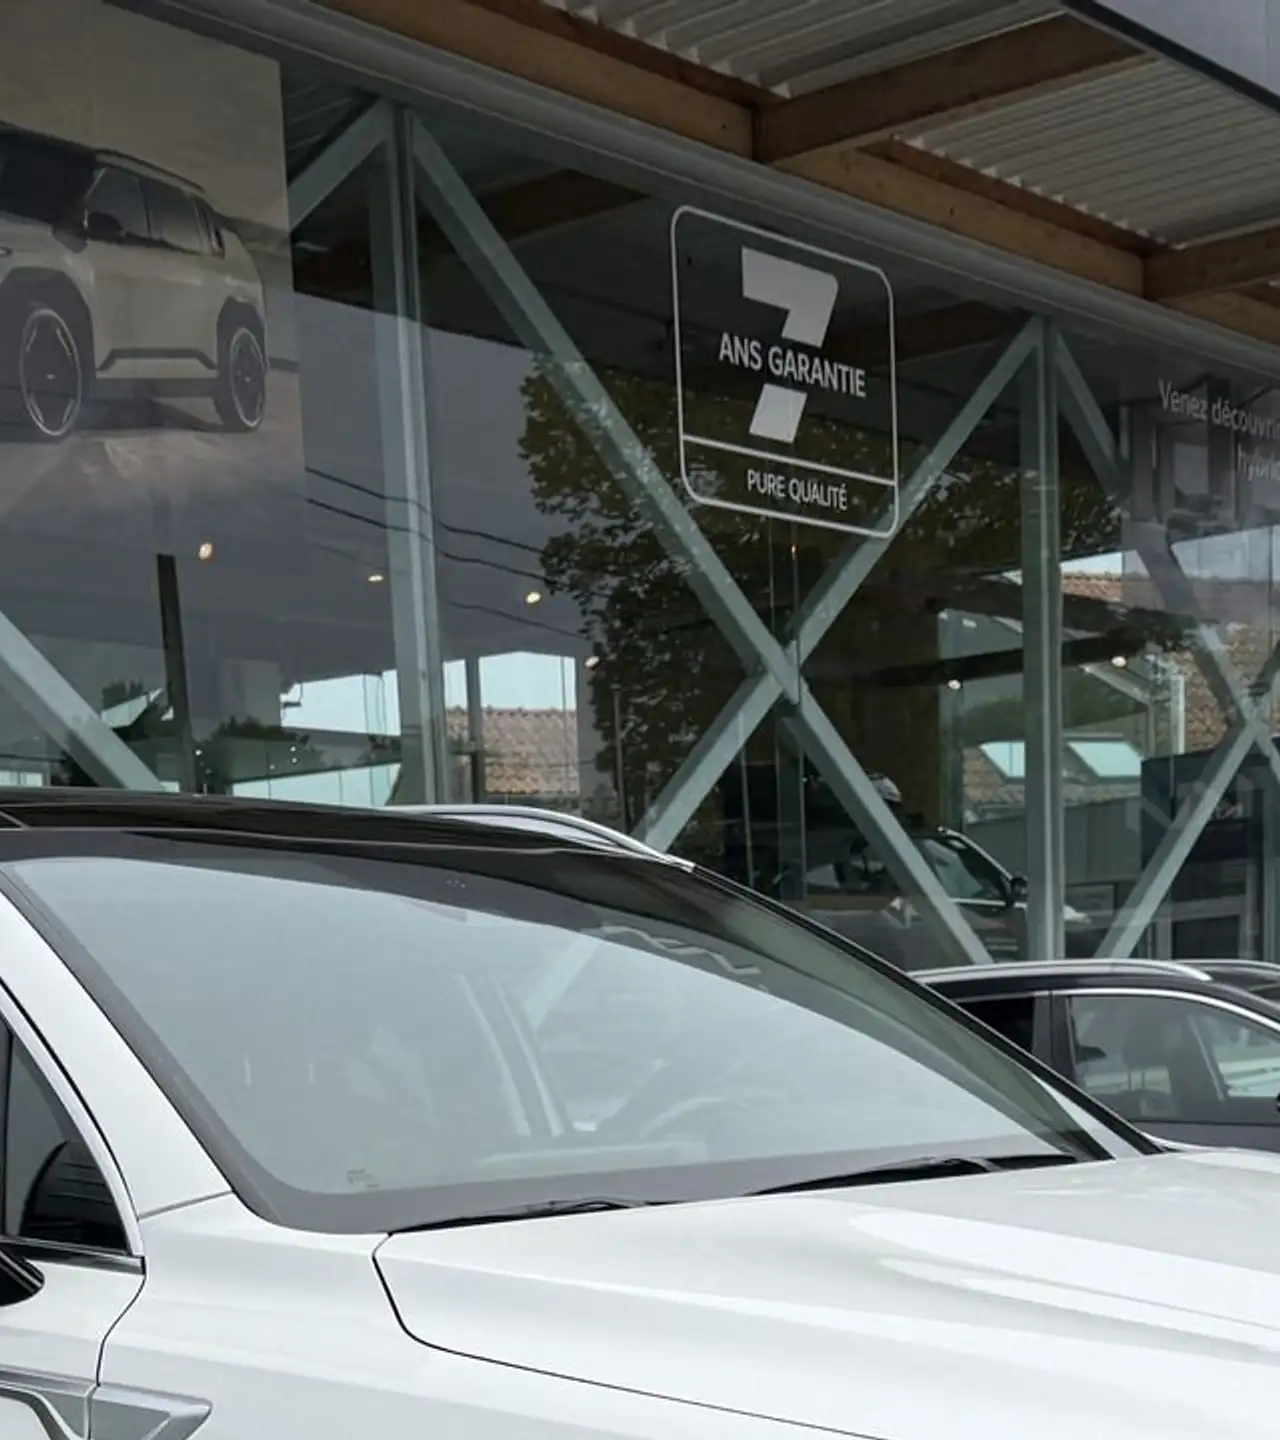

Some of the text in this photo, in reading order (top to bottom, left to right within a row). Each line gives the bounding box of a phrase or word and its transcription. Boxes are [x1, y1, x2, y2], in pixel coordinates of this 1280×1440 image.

[719, 332, 867, 398] ANS GARANTIE
[1157, 377, 1209, 421] Venez
[746, 468, 848, 511] PURE QUALITÉ
